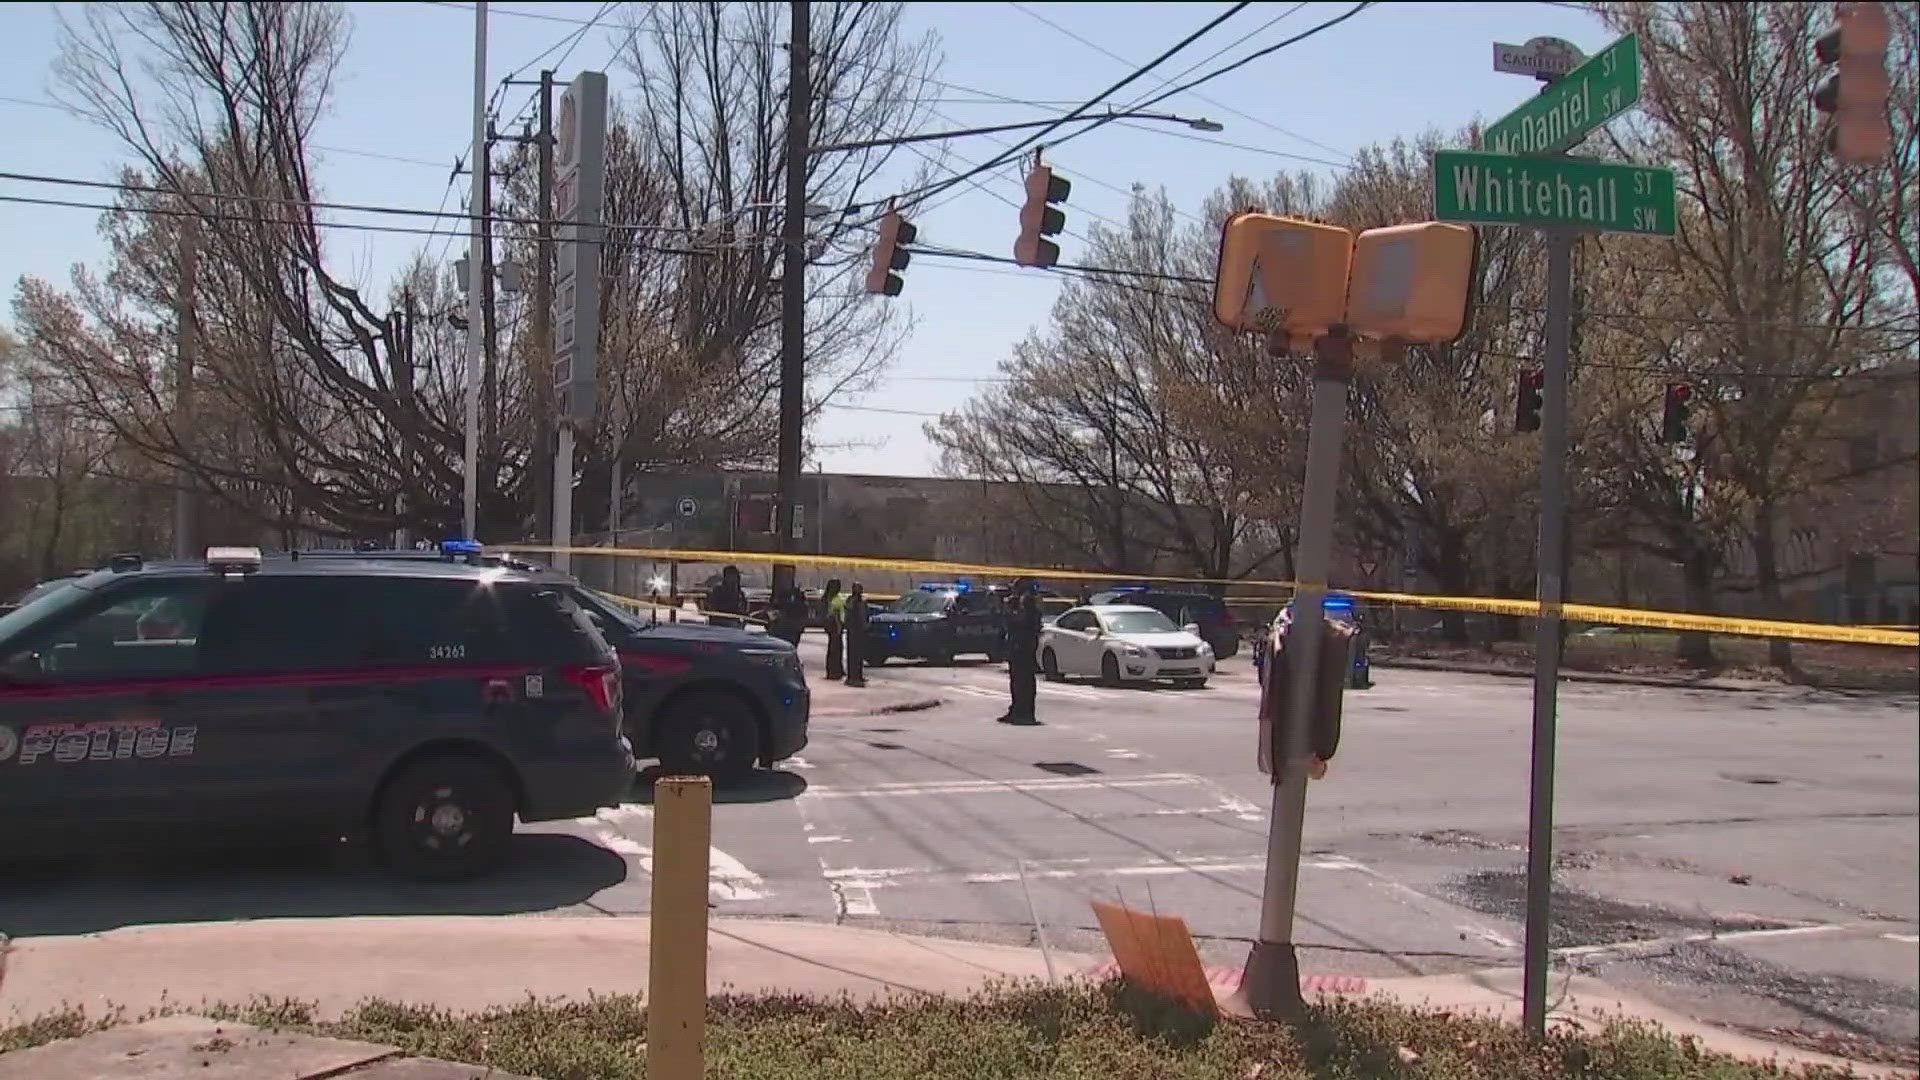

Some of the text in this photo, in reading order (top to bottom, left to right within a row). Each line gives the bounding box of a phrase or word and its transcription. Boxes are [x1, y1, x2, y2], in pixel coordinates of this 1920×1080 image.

[1603, 47, 1616, 77] ST
[1495, 77, 1589, 155] McDaniel
[1603, 87, 1621, 117] SW
[1453, 165, 1653, 222] Whitehall ST
[1633, 208, 1657, 232] SW
[19, 725, 198, 764] POLICE
